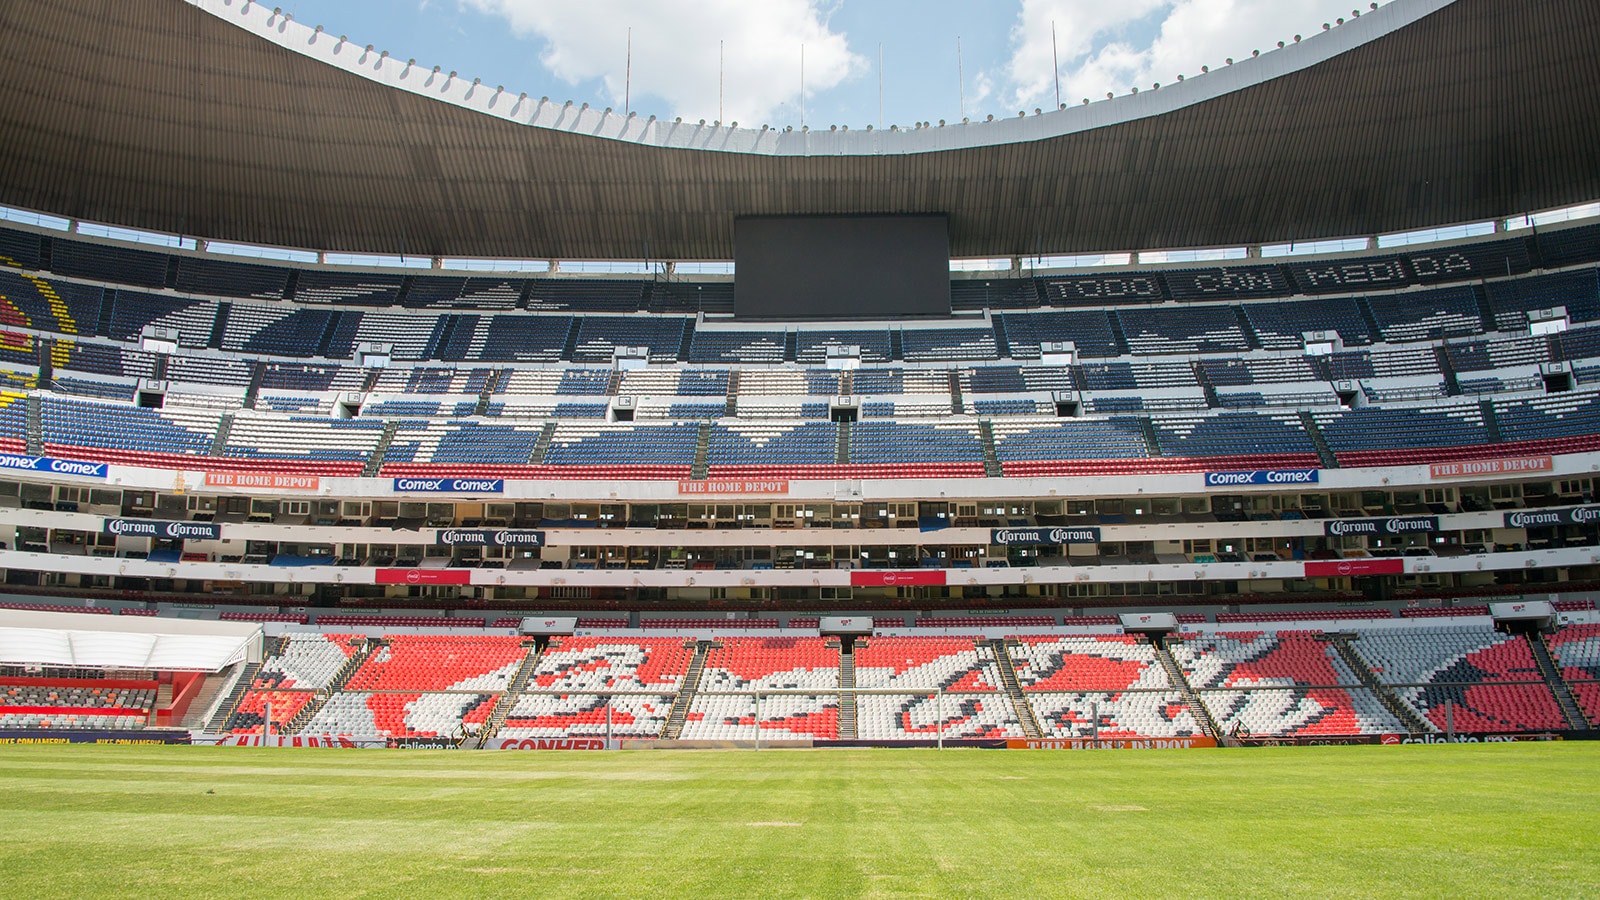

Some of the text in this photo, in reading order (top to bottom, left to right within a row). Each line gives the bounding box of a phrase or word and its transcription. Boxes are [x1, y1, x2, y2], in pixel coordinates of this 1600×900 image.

[1050, 279, 1153, 297] TODO
[1306, 254, 1471, 285] MEDIDA
[0, 456, 104, 476] omex Comex
[1432, 458, 1546, 476] THE HOME DEPOT
[208, 473, 314, 488] THE HOME DEPOT
[1208, 469, 1314, 484] Comex Comex
[398, 478, 499, 491] Comex Comex
[680, 481, 783, 492] THE HOME DEPOT
[1509, 507, 1600, 528] Corona Cor
[109, 518, 214, 538] Corona Corona
[1330, 518, 1434, 536] Corona Corona
[441, 530, 539, 545] Corona Corona
[995, 528, 1095, 544] Corona Corona
[500, 739, 605, 750] GONHER
[1027, 739, 1192, 750] THE HOME DEPOT
